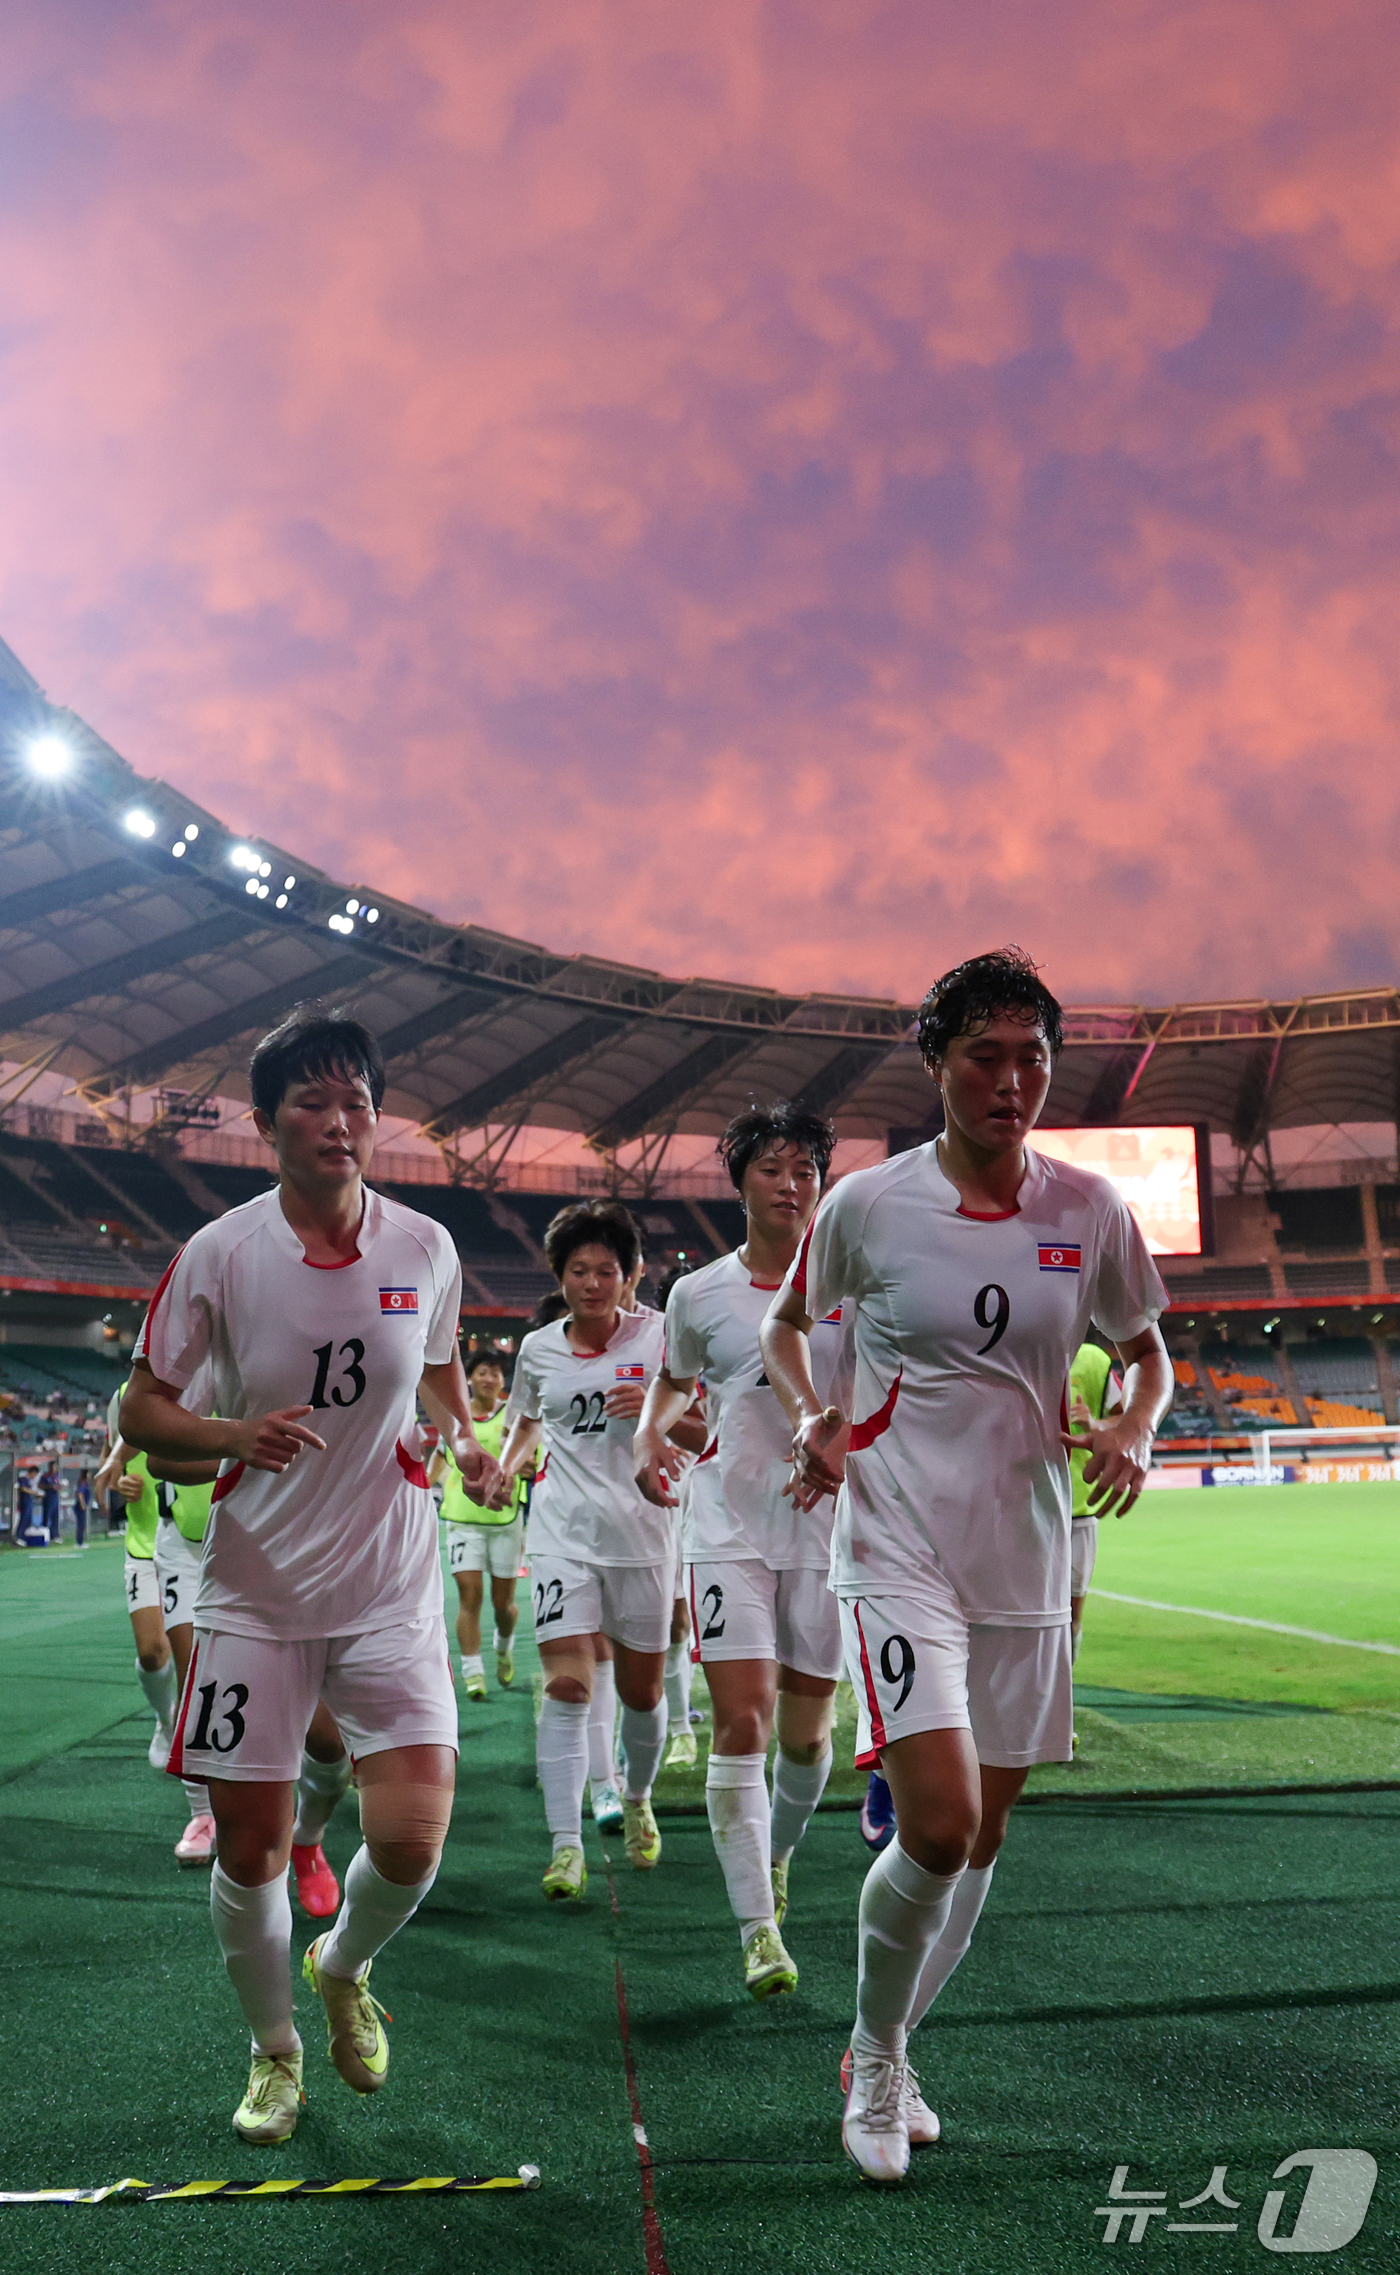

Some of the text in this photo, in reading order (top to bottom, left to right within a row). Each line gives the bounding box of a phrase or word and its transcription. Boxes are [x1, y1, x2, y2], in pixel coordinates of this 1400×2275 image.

[974, 1284, 1010, 1356] 9
[307, 1338, 367, 1410] 13
[570, 1391, 608, 1435] 22
[450, 1542, 466, 1565] 17
[128, 1572, 139, 1603] 4
[164, 1574, 179, 1615] 5
[535, 1578, 564, 1628] 22
[701, 1584, 726, 1641] 2
[881, 1635, 916, 1713] 9
[185, 1680, 249, 1753] 13
